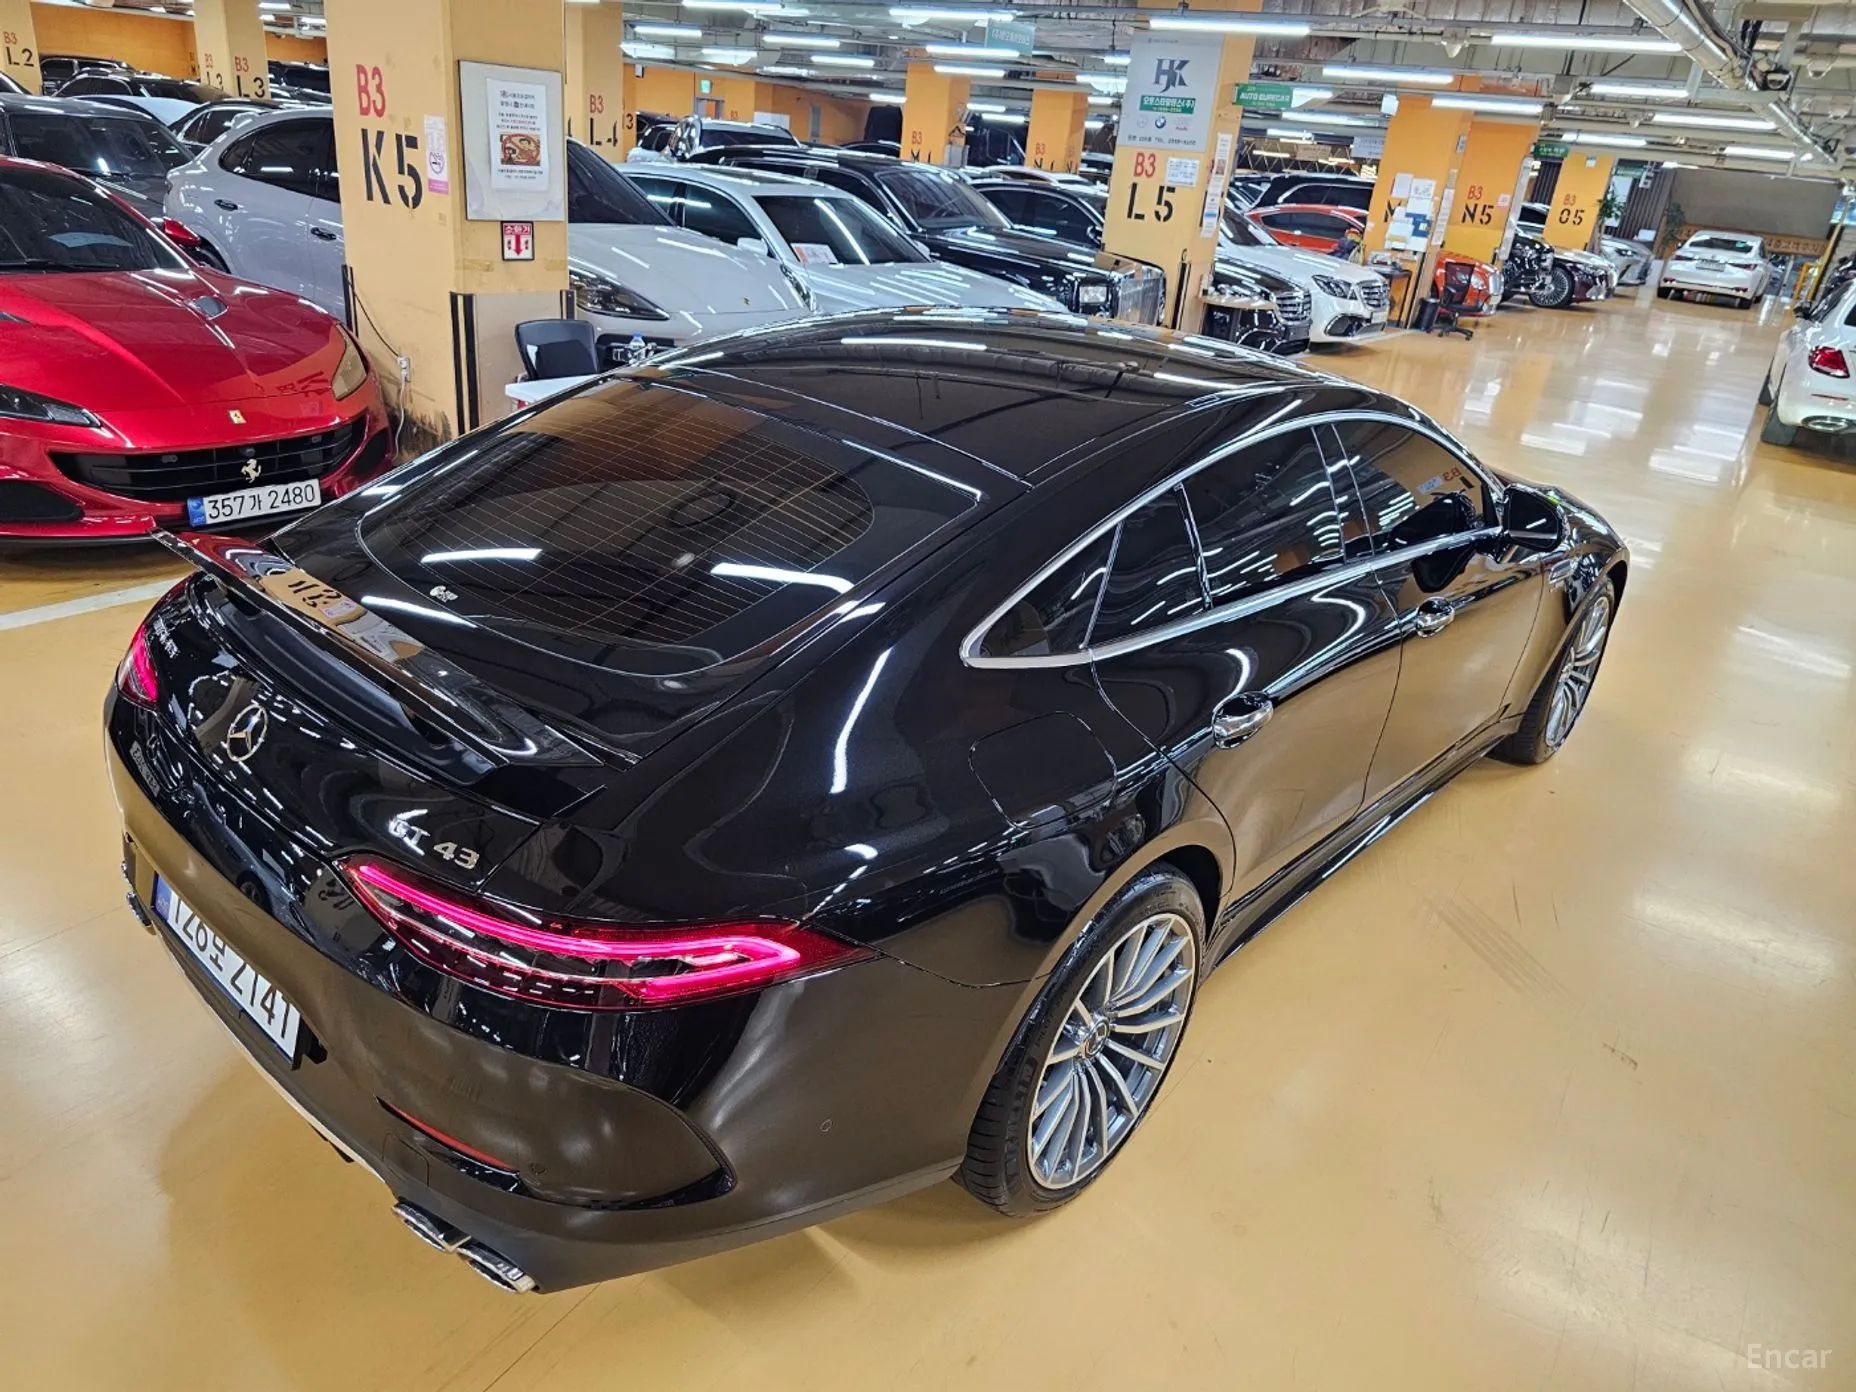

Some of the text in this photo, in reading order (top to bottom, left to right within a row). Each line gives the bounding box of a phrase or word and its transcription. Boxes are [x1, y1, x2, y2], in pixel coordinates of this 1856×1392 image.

[3, 31, 18, 45] B3
[6, 46, 35, 68] L2
[234, 56, 250, 73] B3
[236, 75, 266, 99] L3
[356, 64, 387, 119] B3
[590, 94, 604, 114] B3
[912, 131, 922, 145] B3
[361, 128, 423, 210] K5
[1133, 152, 1156, 178] B3
[1127, 182, 1176, 222] L5
[1468, 186, 1483, 200] B3
[1563, 194, 1577, 206] B3
[1461, 203, 1494, 225] N5
[208, 484, 315, 519] 357가 2480
[433, 842, 480, 870] 43
